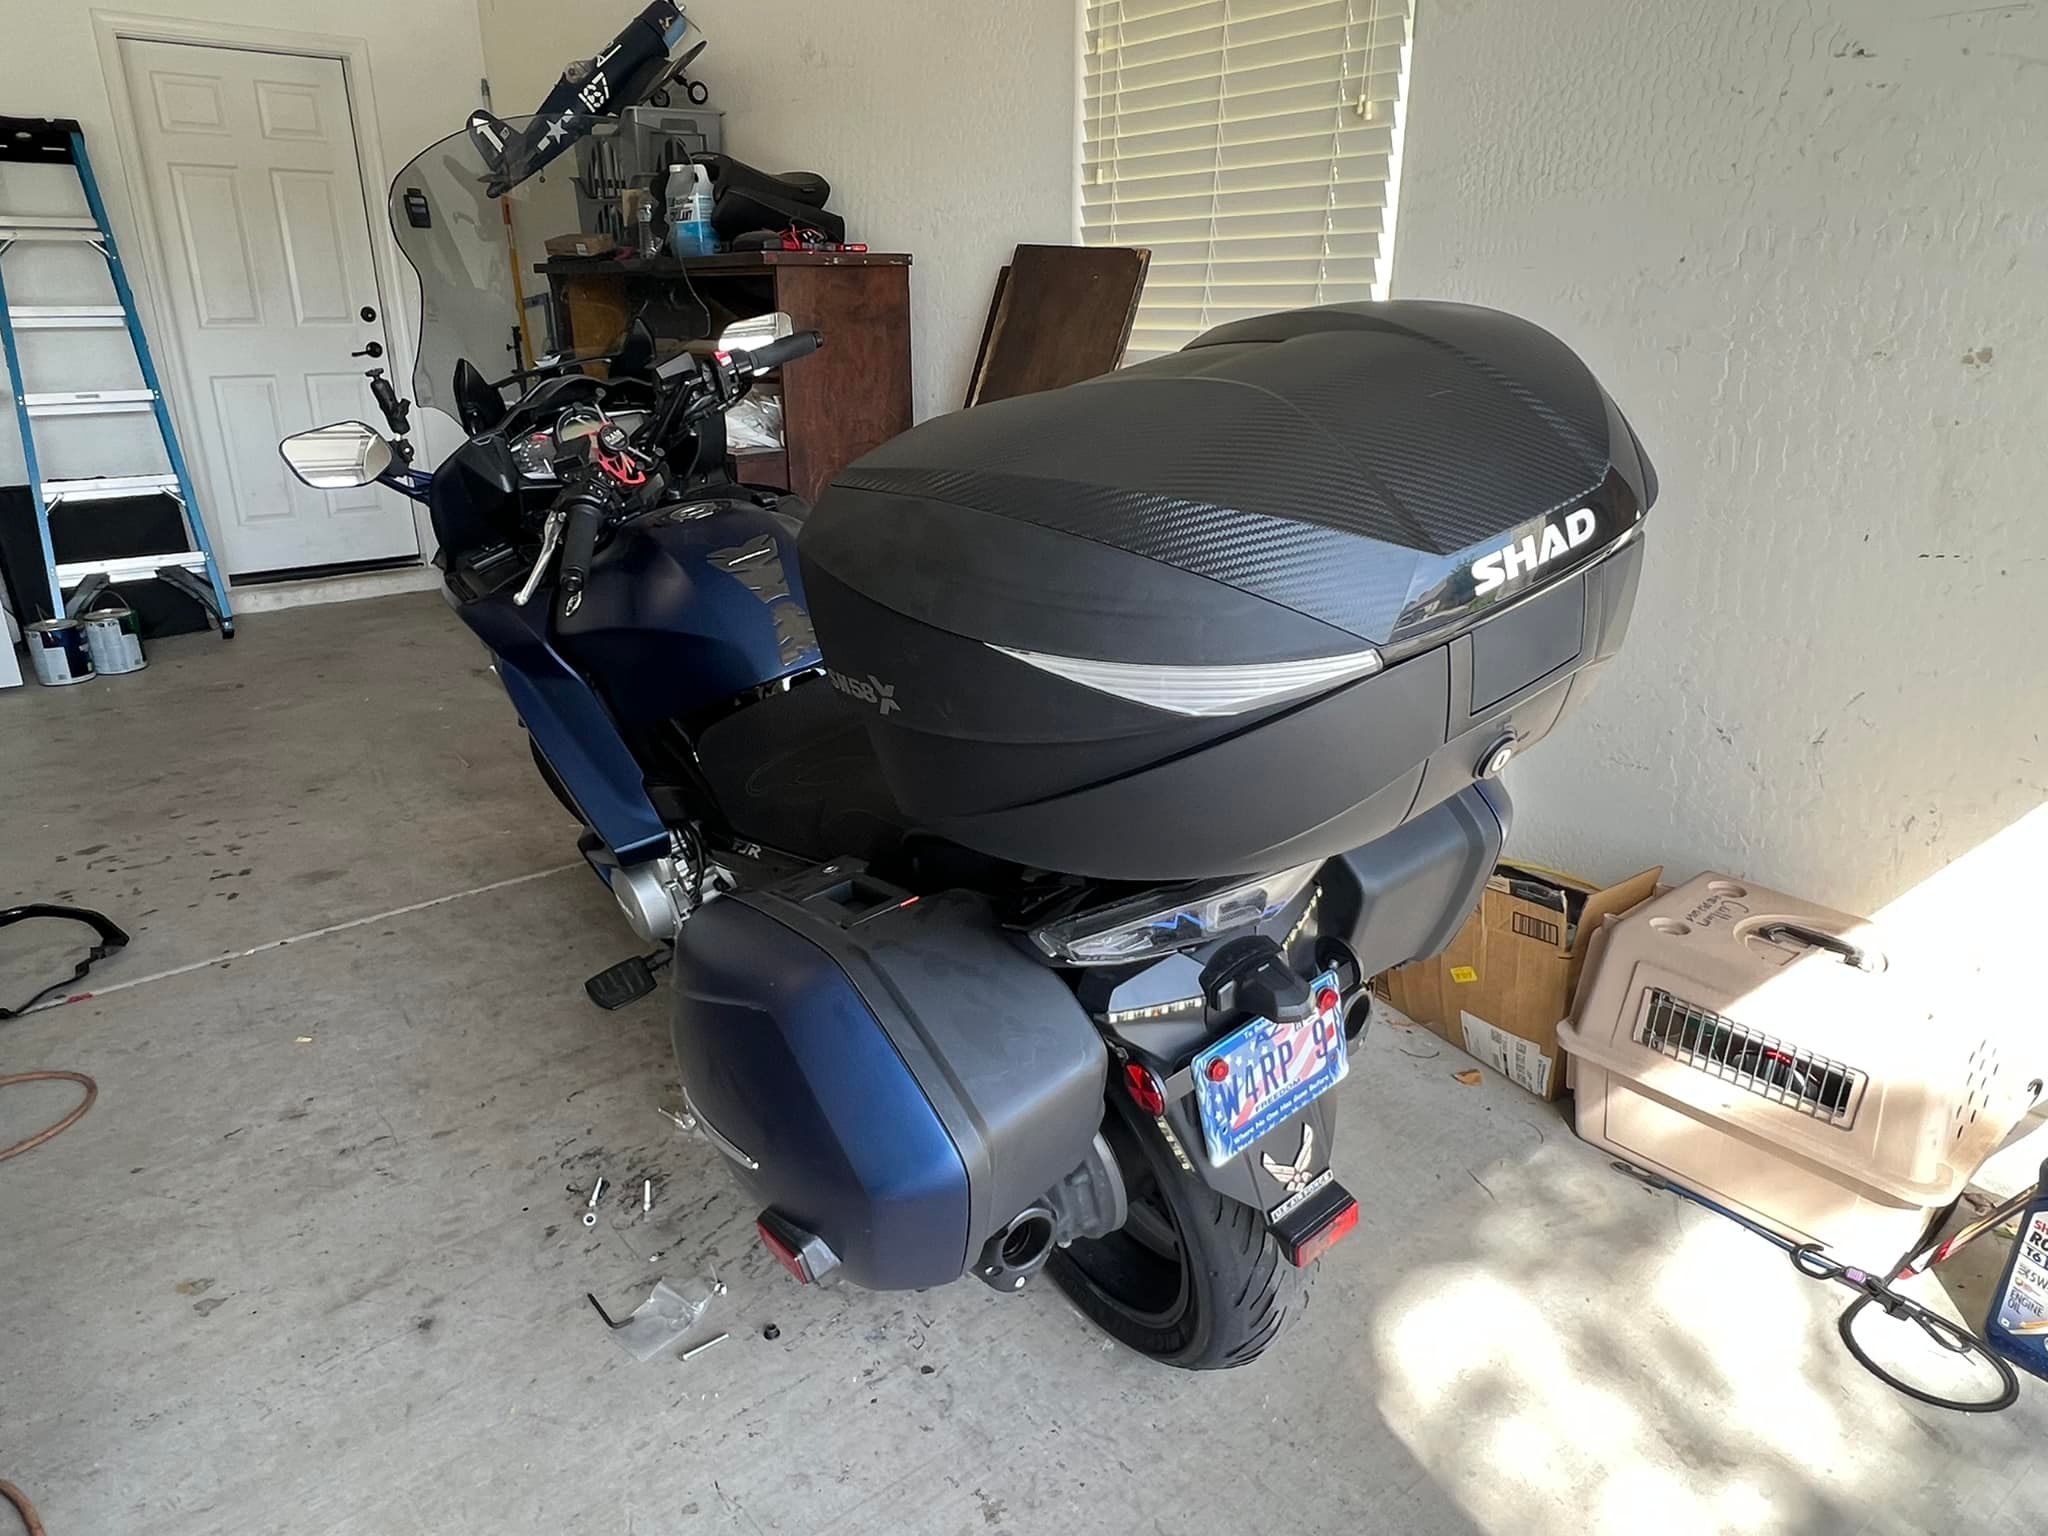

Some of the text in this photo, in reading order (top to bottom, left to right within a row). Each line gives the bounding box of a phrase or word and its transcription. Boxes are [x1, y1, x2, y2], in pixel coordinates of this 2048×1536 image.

[578, 72, 610, 113] 167
[1471, 508, 1596, 597] SHAD
[1219, 1018, 1330, 1122] W4RP 9
[1233, 1126, 1255, 1144] Where
[1255, 1119, 1266, 1129] No
[1266, 1109, 1279, 1121] One
[1309, 1075, 1330, 1092] Before
[1255, 1078, 1301, 1112] FREEDOM
[2026, 1246, 2042, 1263] T6
[2007, 1298, 2021, 1315] OIL
[2009, 1288, 2044, 1317] ENGINE
